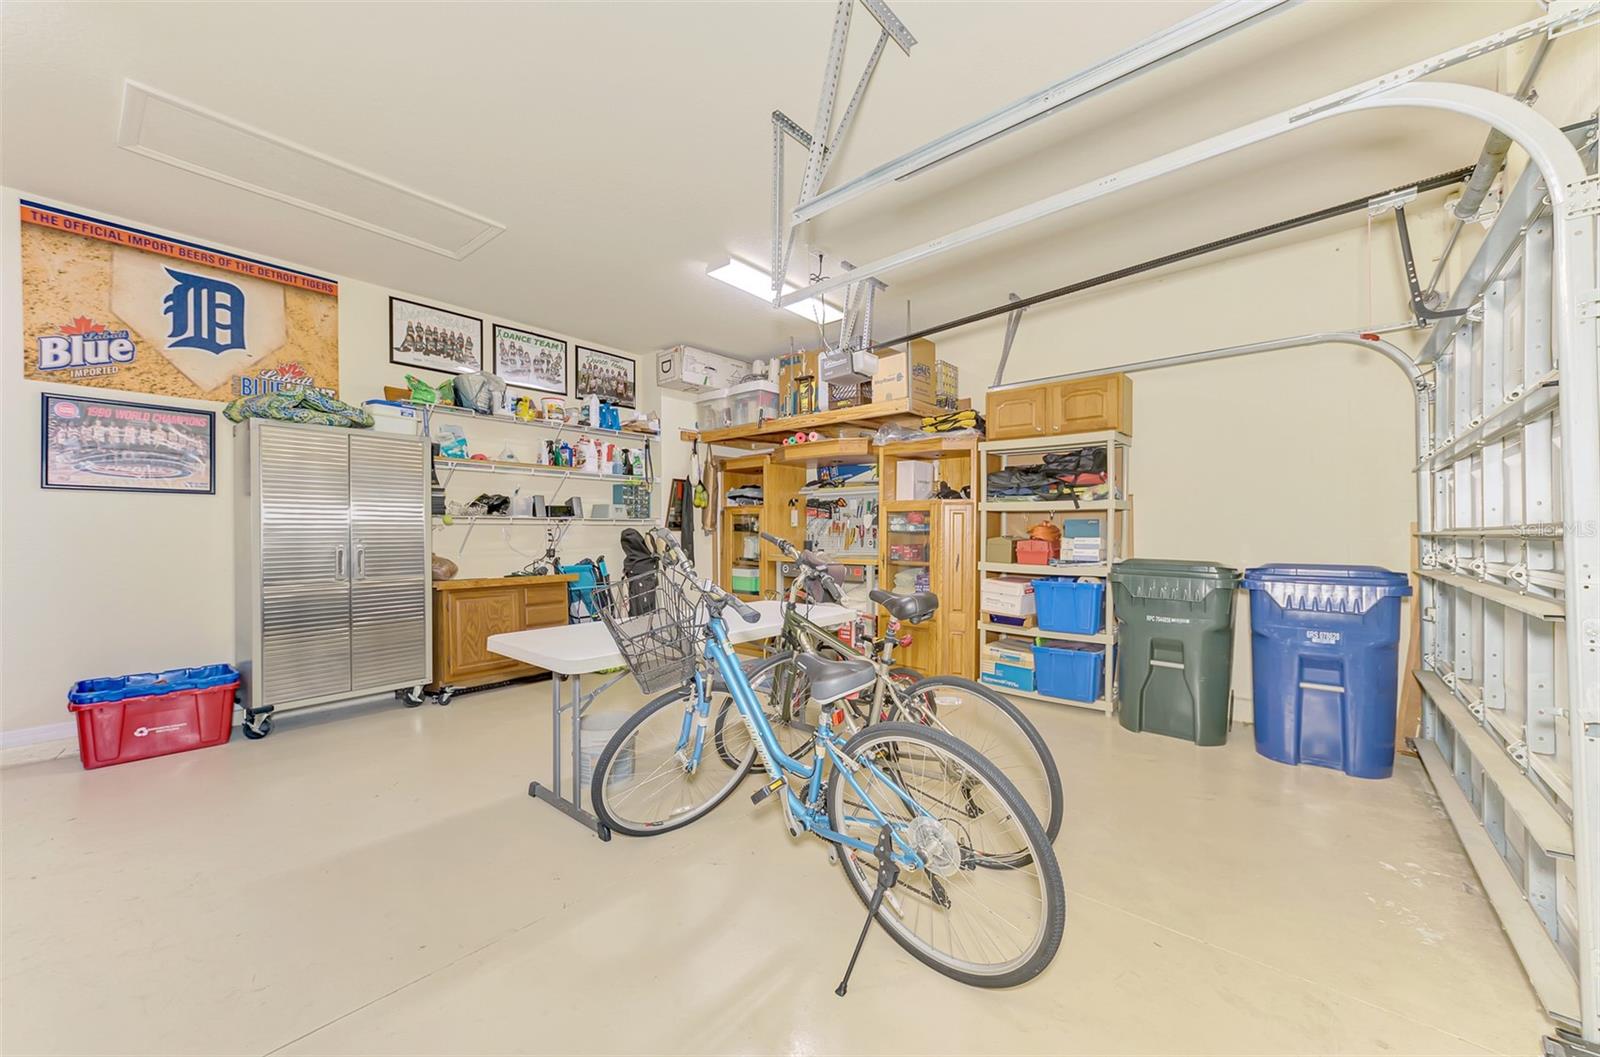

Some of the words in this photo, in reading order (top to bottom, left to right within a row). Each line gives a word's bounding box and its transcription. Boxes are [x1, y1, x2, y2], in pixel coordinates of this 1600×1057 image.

[31, 210, 58, 226] THE
[63, 218, 123, 242] OFFICIAL
[128, 235, 175, 254] IMPORT
[179, 247, 215, 264] BEERS
[219, 257, 232, 267] OF
[235, 261, 256, 274] THE
[258, 266, 297, 285] DETROIT
[302, 278, 334, 293] TIGERS
[503, 331, 531, 344] DANCE
[534, 339, 559, 350] TEAM
[38, 333, 135, 370] Blue
[70, 366, 119, 378] IMPORTED
[260, 369, 313, 386] Labatt
[87, 406, 112, 418] 1990
[115, 408, 150, 421] WORLD
[151, 413, 208, 428] CHAMPIONS
